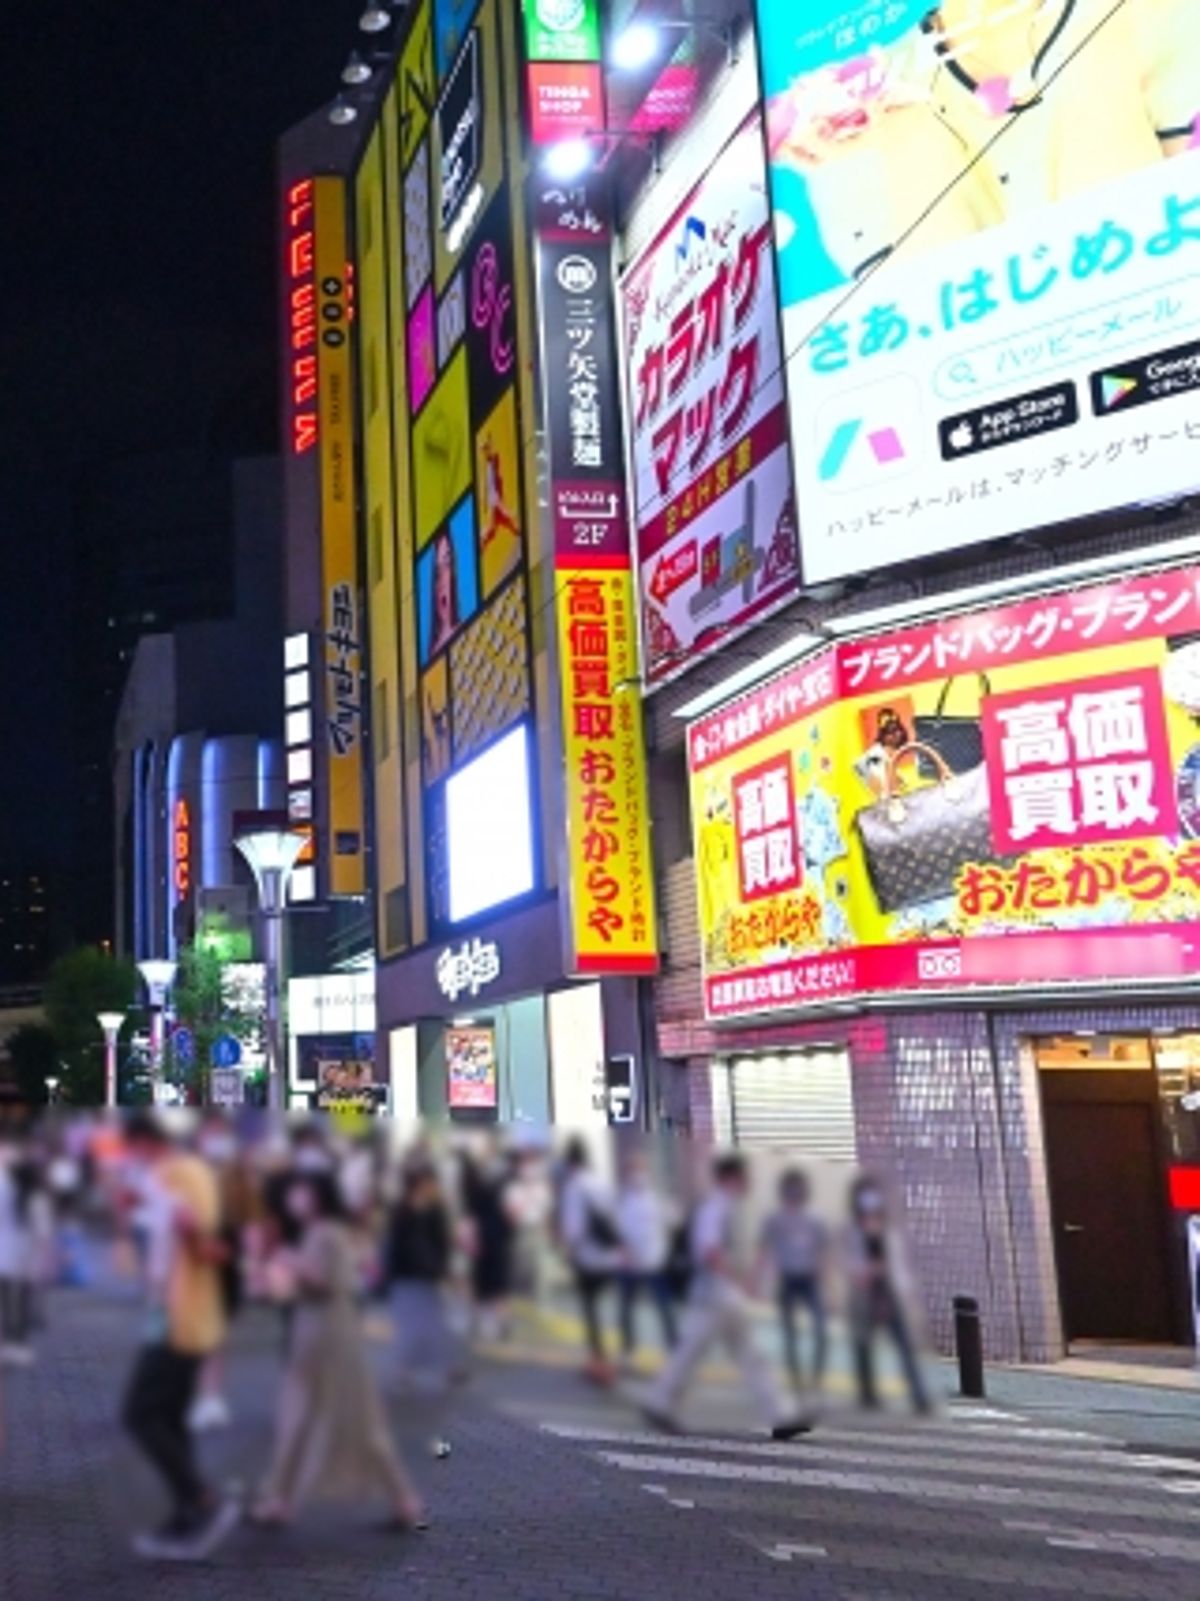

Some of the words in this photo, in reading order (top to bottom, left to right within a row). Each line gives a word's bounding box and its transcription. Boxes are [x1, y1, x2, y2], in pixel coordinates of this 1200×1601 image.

[996, 297, 1183, 374] ハッピーメール
[1146, 354, 1200, 379] Goog
[978, 406, 1017, 431] App
[573, 522, 608, 545] 2F
[842, 582, 1200, 687] ブランドバッグ・ブラン
[996, 686, 1148, 773] 高価
[737, 766, 789, 837] 高価
[1004, 760, 1160, 842] 買取
[742, 831, 797, 893] 買取
